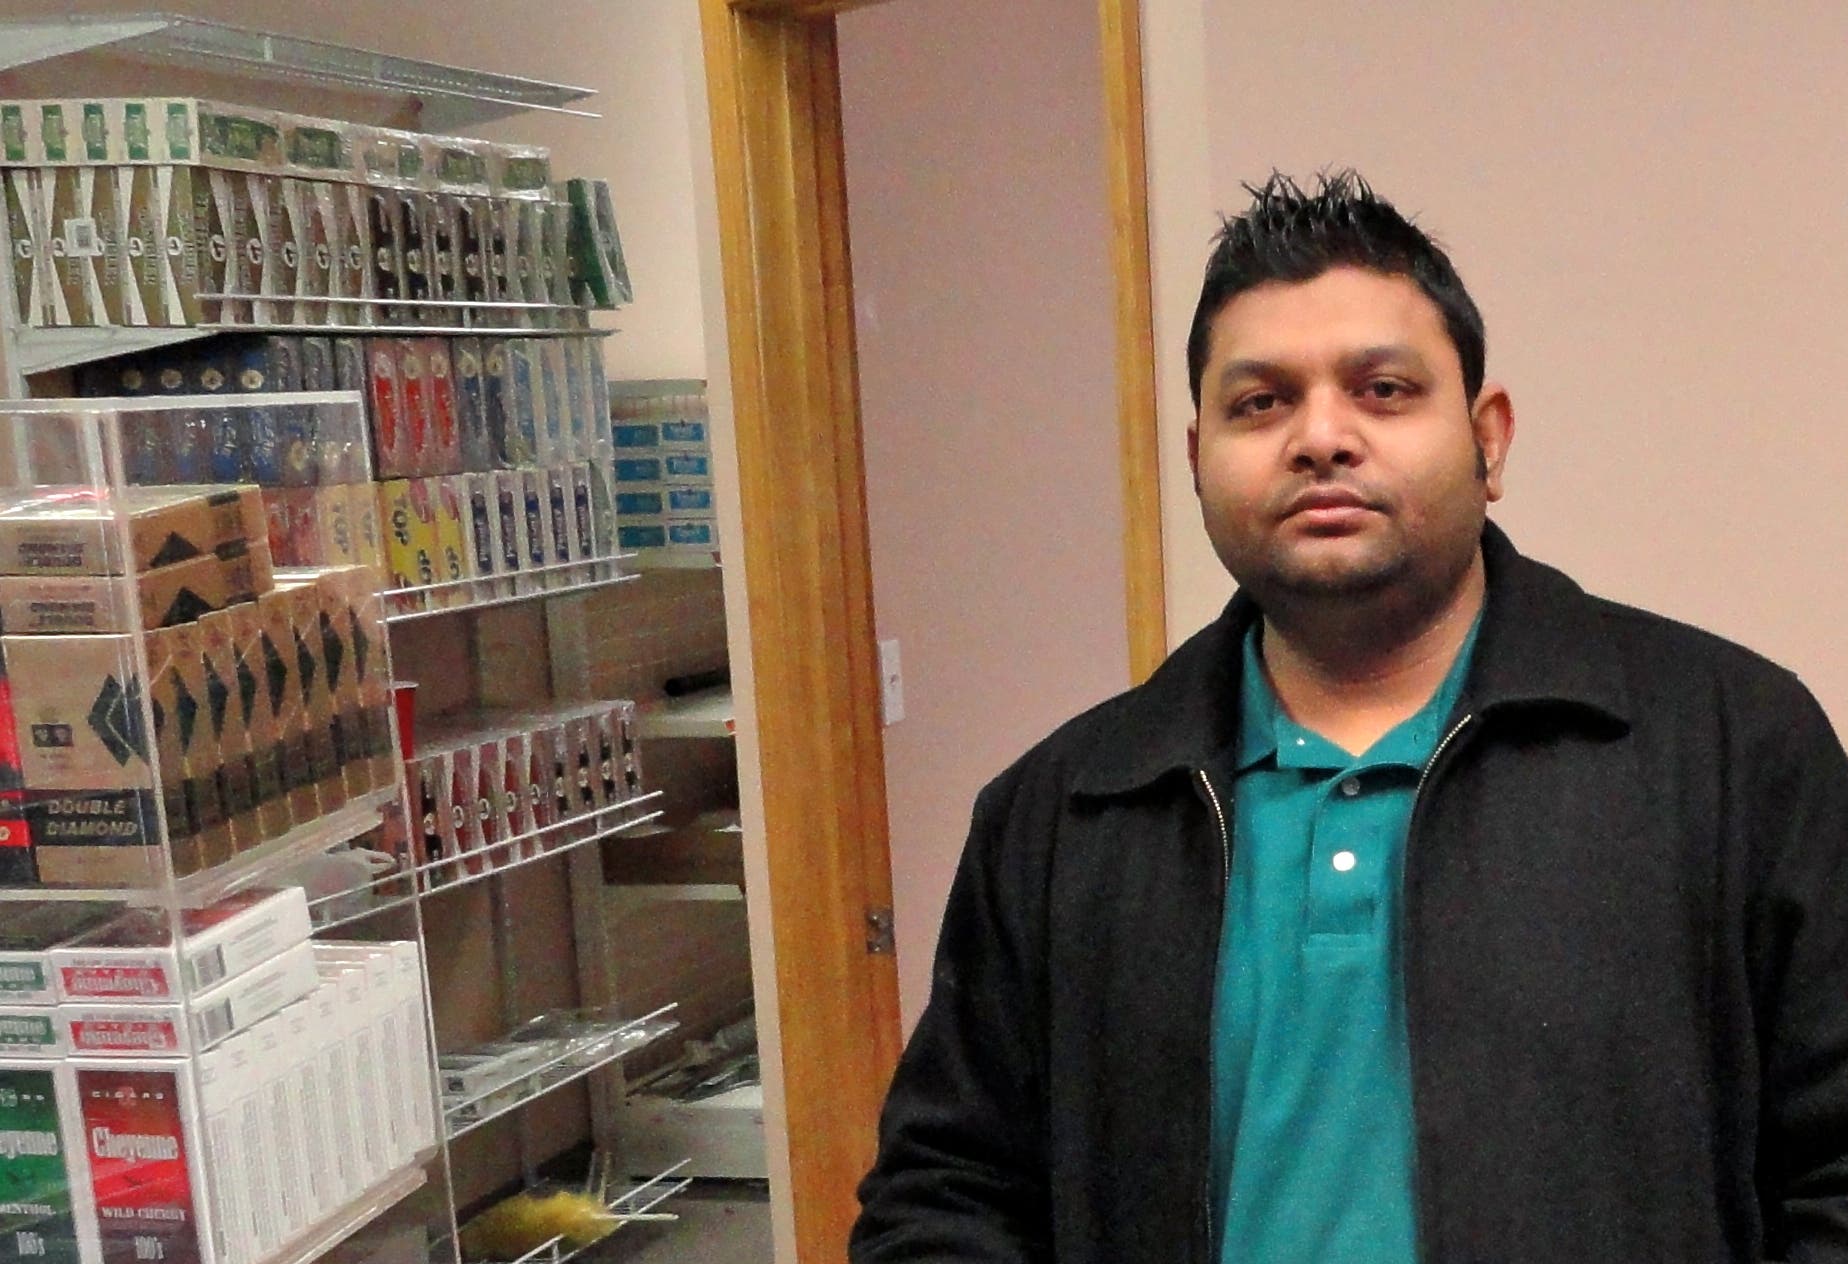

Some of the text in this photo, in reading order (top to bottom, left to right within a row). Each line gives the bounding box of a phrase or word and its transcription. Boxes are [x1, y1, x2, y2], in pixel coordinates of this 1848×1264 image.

[48, 799, 127, 815] DOUBLE
[46, 820, 138, 836] DIAMOND
[91, 1091, 164, 1100] CIGARS
[92, 1126, 179, 1163] Cheyenne
[102, 1206, 187, 1222] WILD CHERRY
